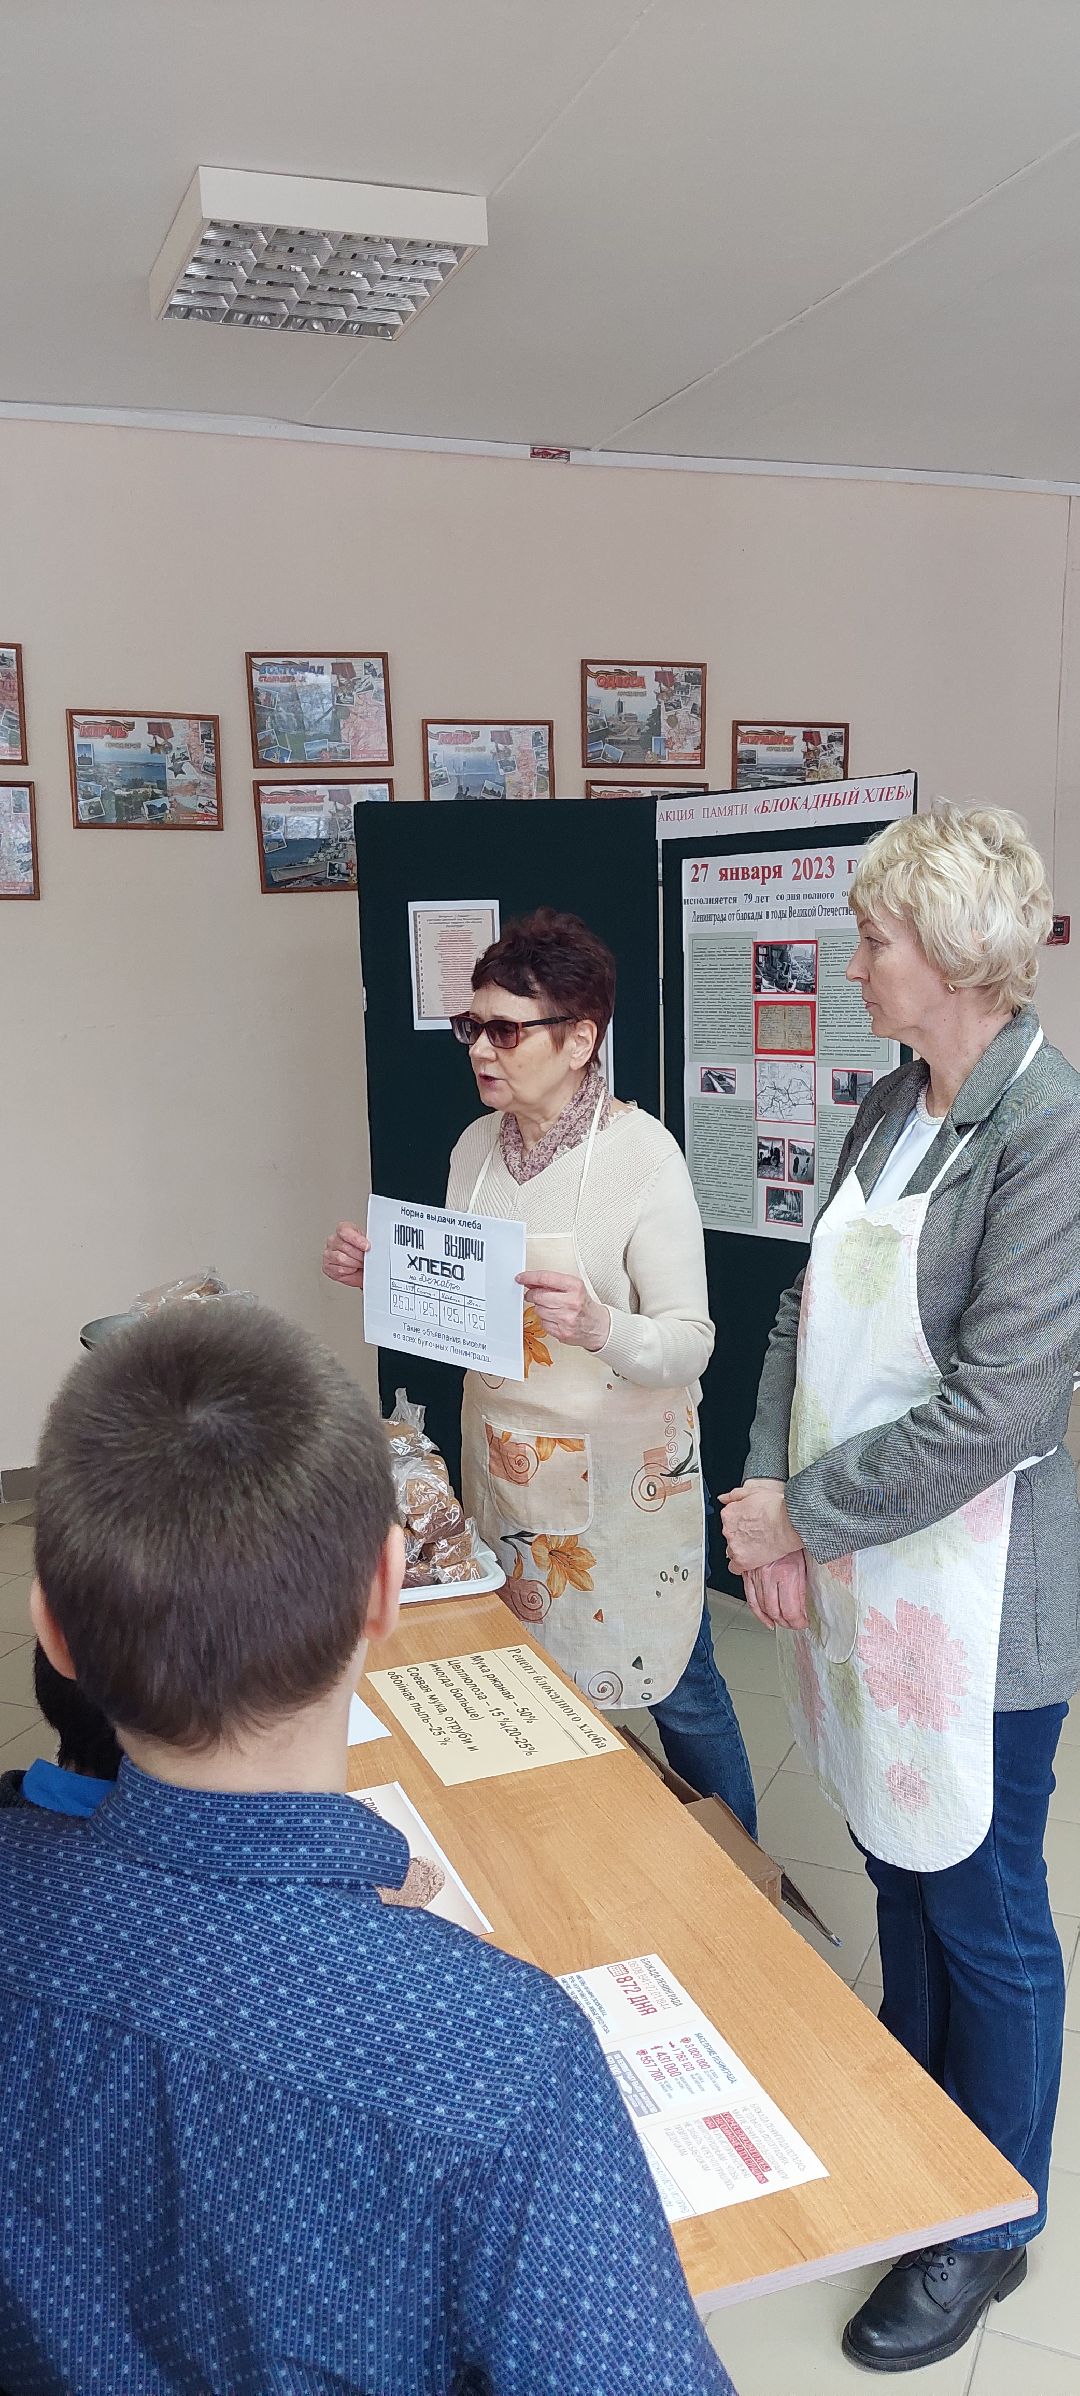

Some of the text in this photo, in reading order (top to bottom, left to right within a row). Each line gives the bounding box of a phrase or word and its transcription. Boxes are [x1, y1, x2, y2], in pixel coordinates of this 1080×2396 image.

[658, 784, 913, 823] АКЦИЯ ПАМЯТИ «БЛОКАДНЫЙ ХЛЕБ»
[690, 863, 709, 882] 27
[718, 863, 783, 886] января
[791, 855, 836, 881] 2023
[743, 893, 753, 904] 79
[754, 895, 770, 904] лет
[802, 891, 835, 901] полного
[691, 910, 727, 926] Ленинграда
[788, 905, 817, 919] Великой
[426, 1213, 456, 1225] выдачи
[457, 1219, 482, 1231] хлеба
[394, 1223, 484, 1263] НОРМА ВЫДАЧИ
[387, 1671, 416, 1702] обойная
[428, 1662, 485, 1721] иногда больше)
[446, 1659, 488, 1701] Целлюлоза
[488, 1707, 506, 1717] 15
[469, 1655, 491, 1674] Мука
[482, 1673, 516, 1701] ржаная
[516, 1707, 539, 1724] 50%
[507, 1648, 607, 1749] Рецепт блокадного хлеба
[406, 1666, 433, 1694] Соевая
[426, 1693, 448, 1716] мука,
[444, 1716, 473, 1745] отруби
[615, 1975, 642, 1995] 872
[626, 1994, 658, 2016] ДНЯ
